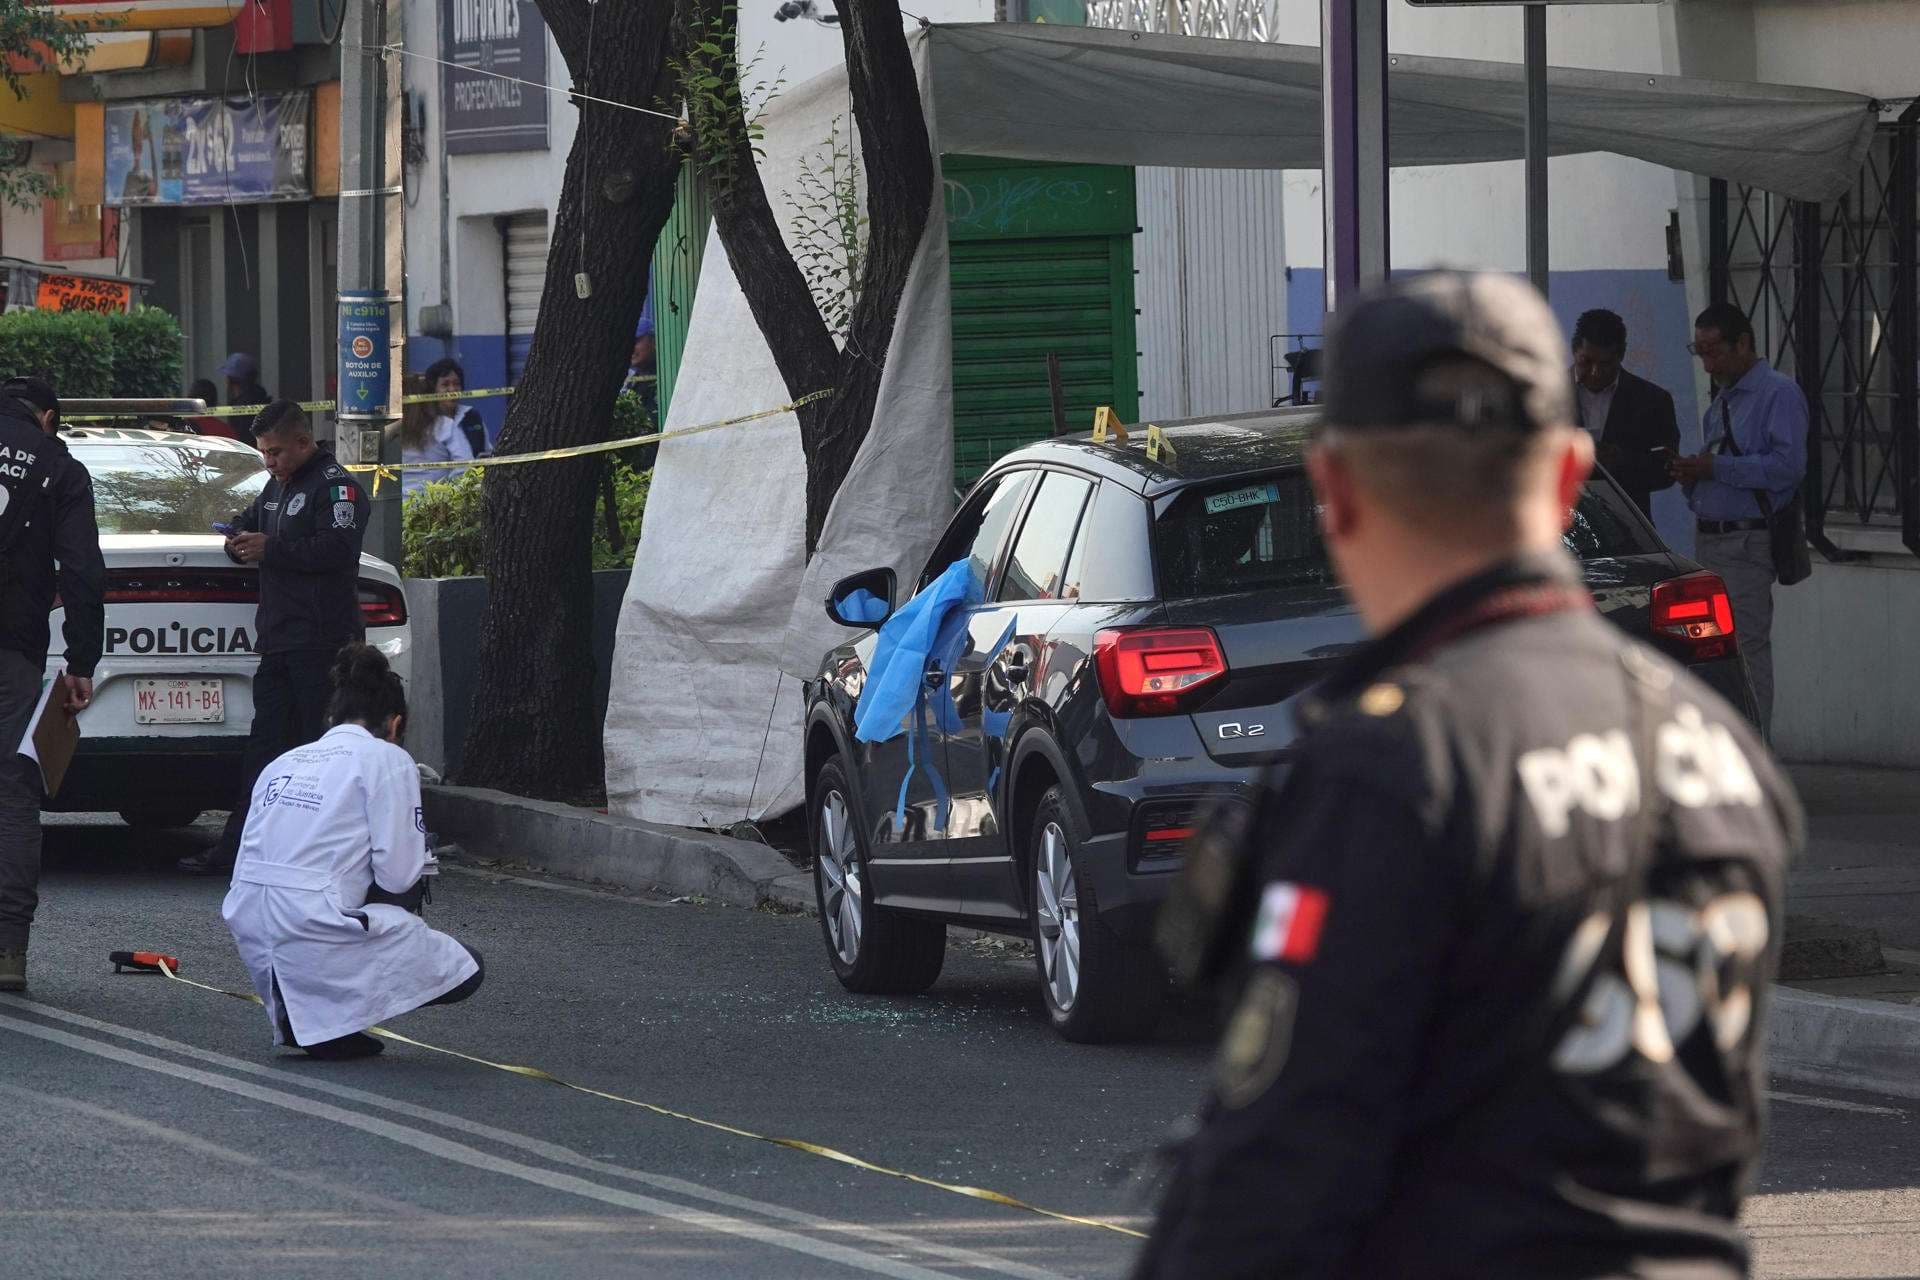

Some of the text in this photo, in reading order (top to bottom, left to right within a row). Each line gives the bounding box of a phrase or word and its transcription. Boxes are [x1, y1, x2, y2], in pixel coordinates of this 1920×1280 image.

[454, 79, 521, 110] PROFESIONALES
[345, 361, 369, 369] BOTÓN
[15, 450, 37, 466] DE
[106, 627, 253, 653] POLICIA
[138, 690, 221, 711] MX-141-B4
[1218, 722, 1265, 740] Q2
